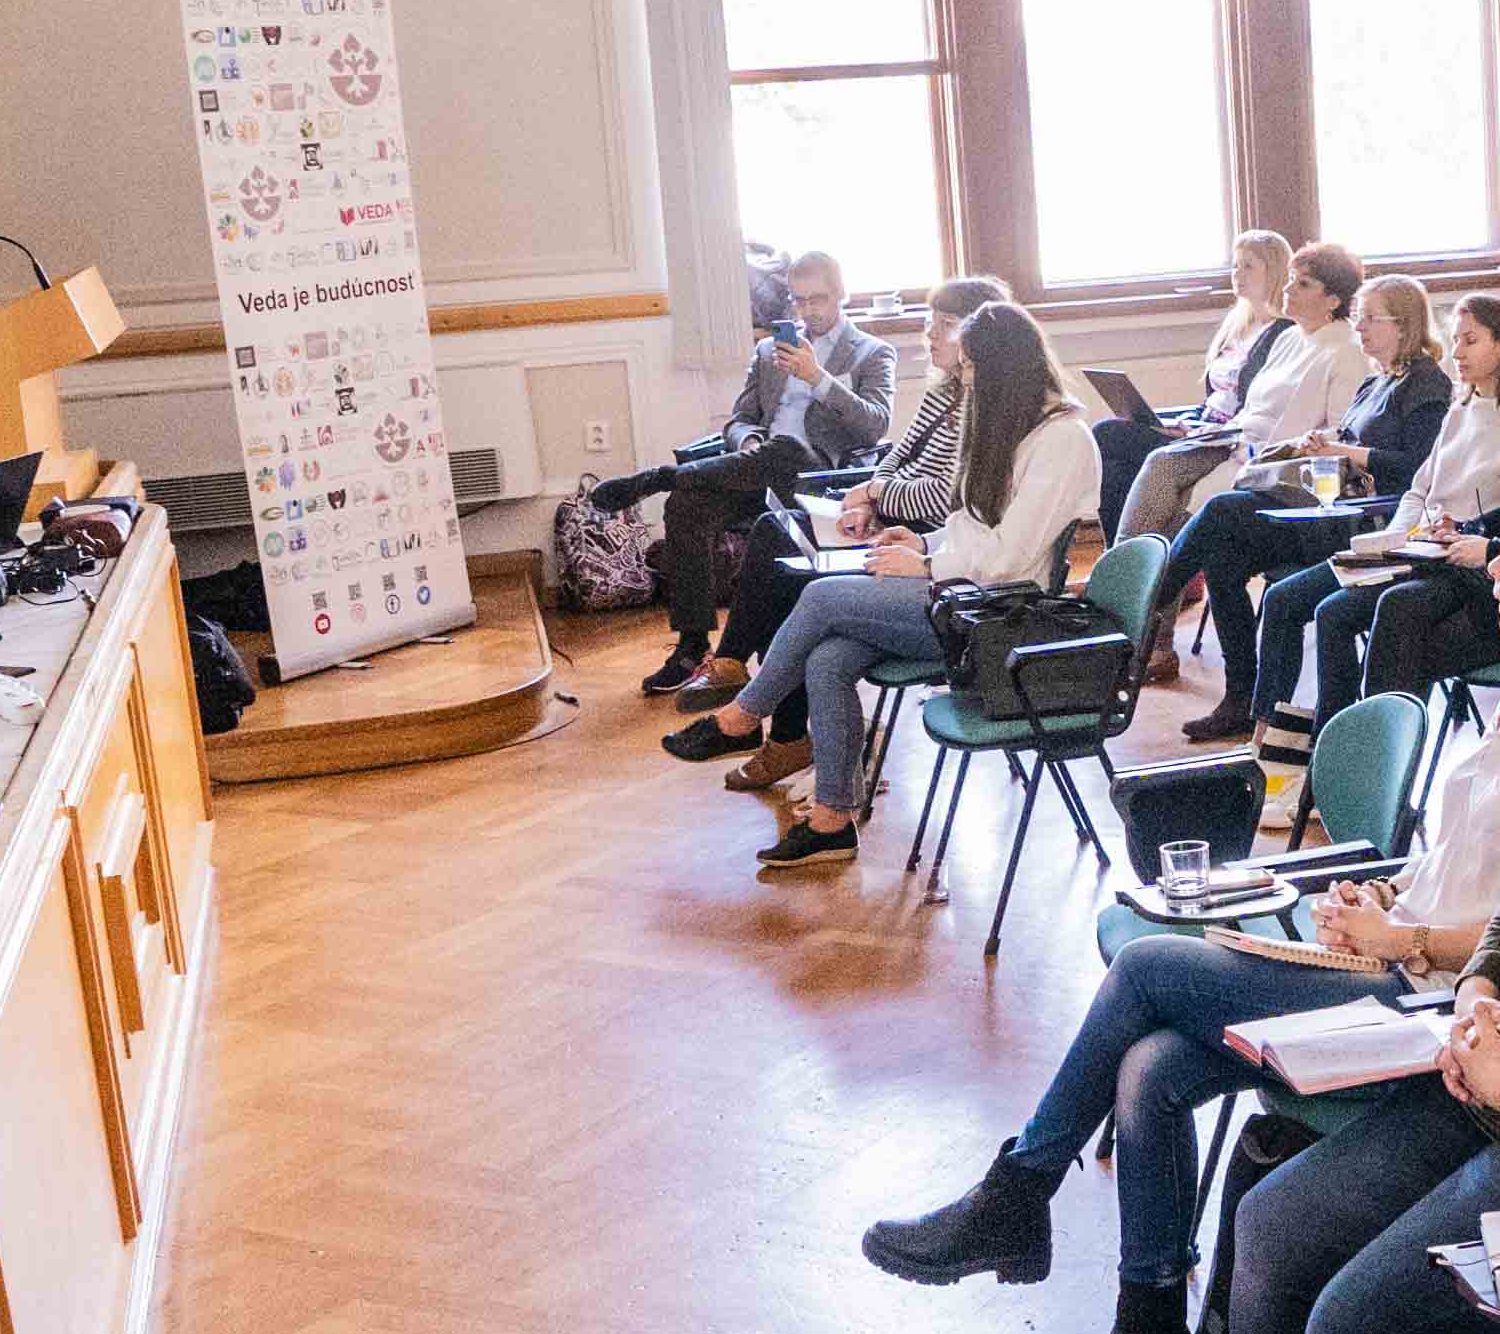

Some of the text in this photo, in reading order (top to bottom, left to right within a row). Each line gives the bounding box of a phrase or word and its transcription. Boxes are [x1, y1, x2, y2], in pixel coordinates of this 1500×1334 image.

[356, 203, 394, 220] VEDA
[238, 290, 288, 314] Veda
[293, 285, 310, 312] je
